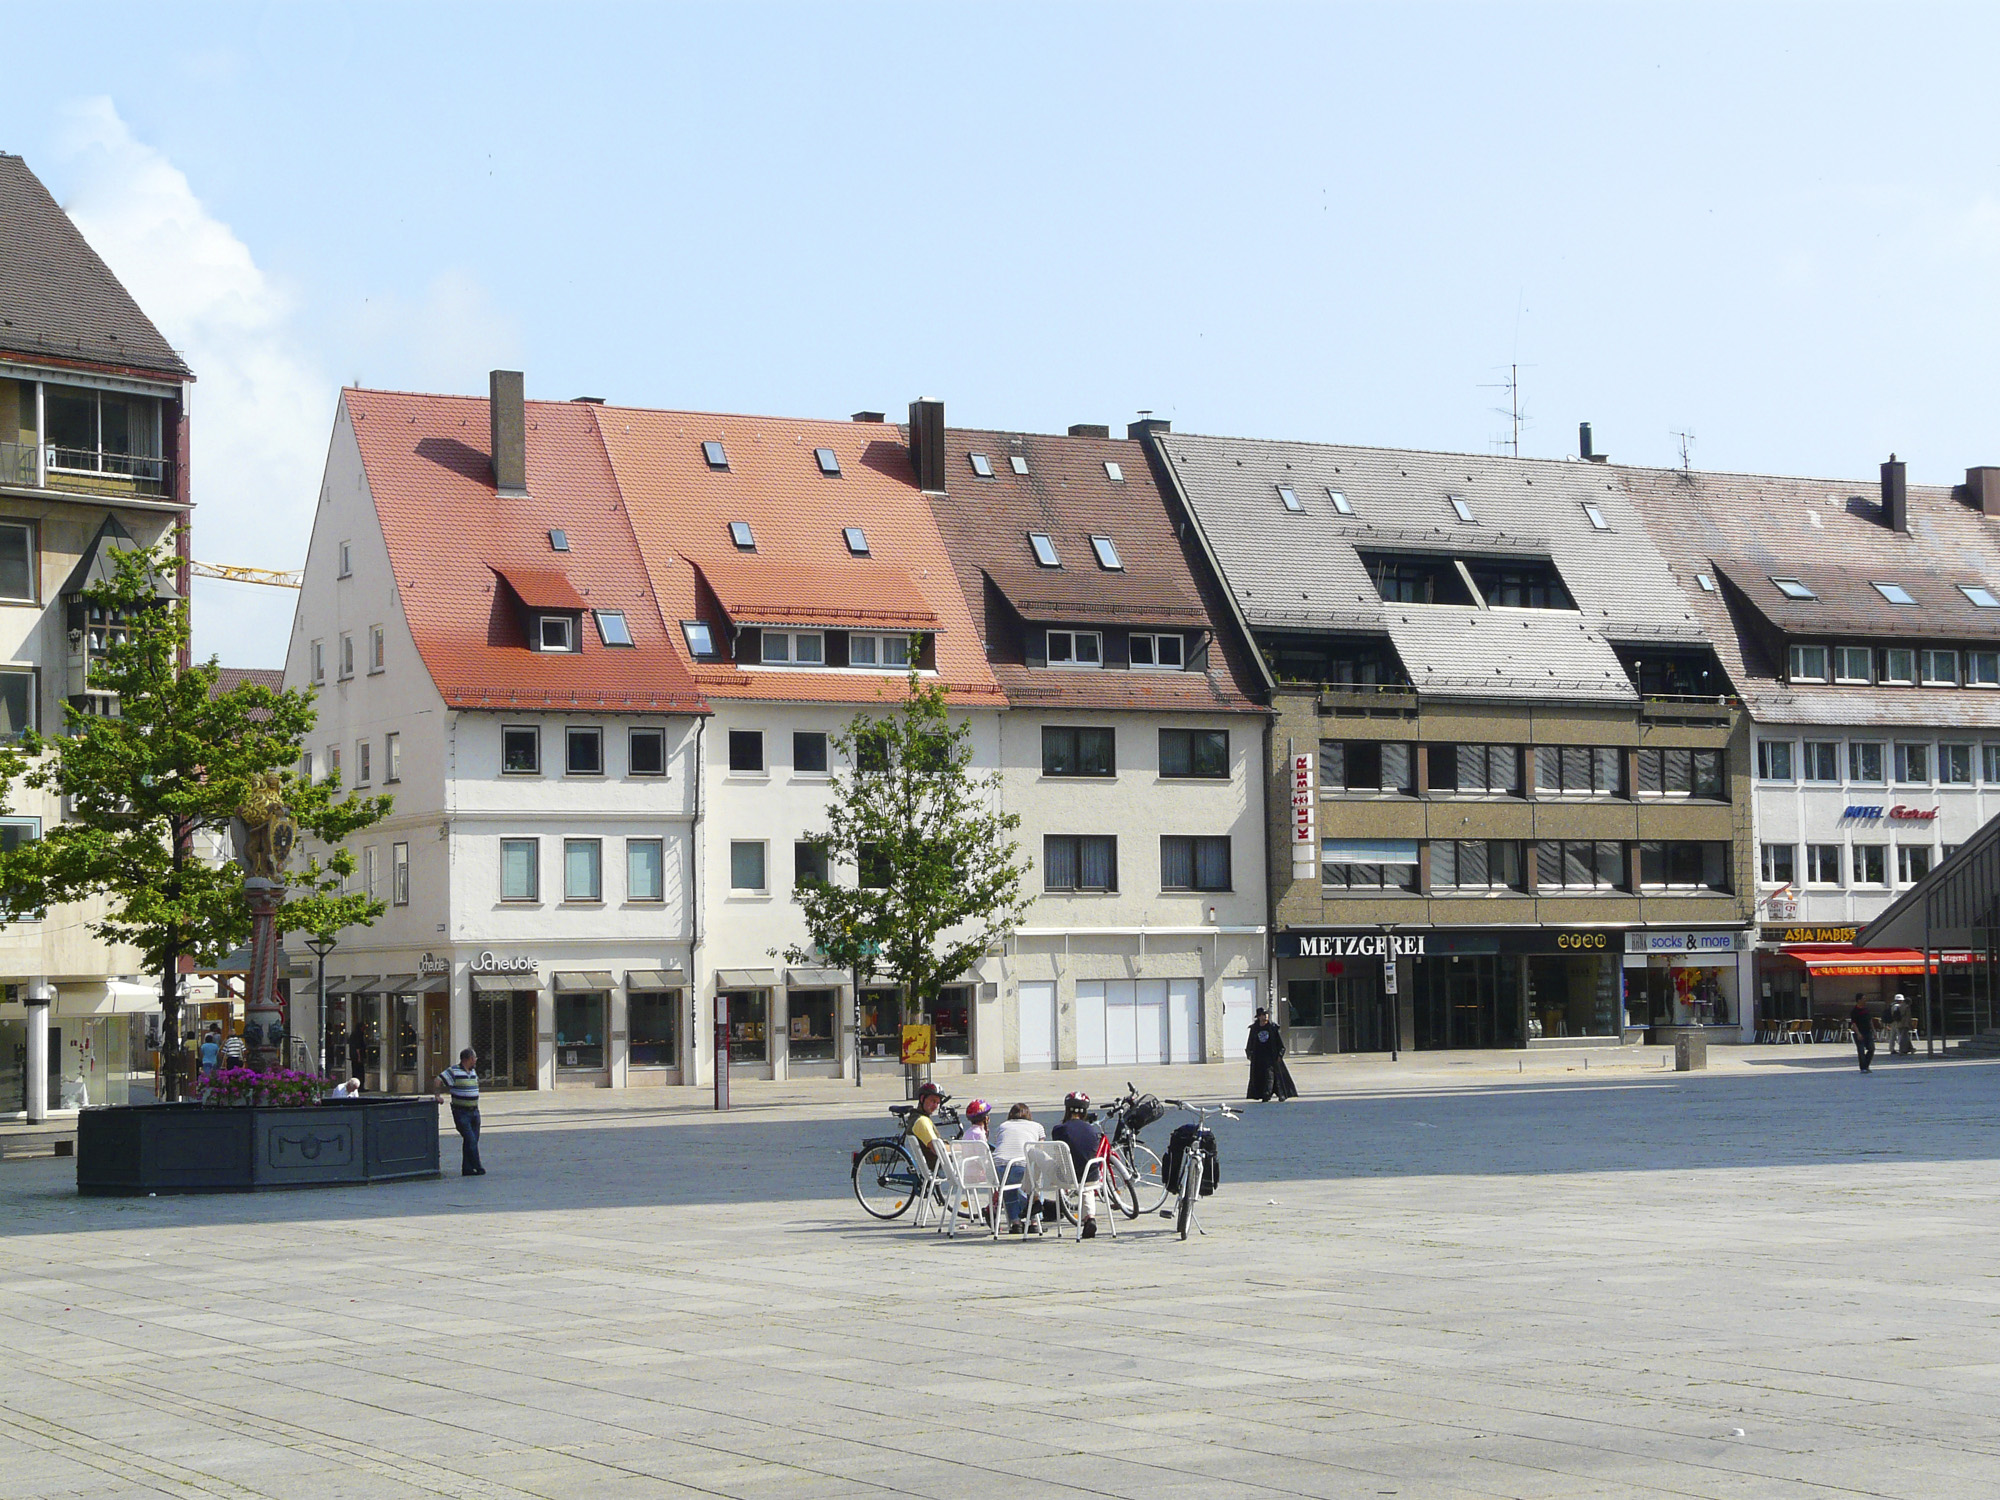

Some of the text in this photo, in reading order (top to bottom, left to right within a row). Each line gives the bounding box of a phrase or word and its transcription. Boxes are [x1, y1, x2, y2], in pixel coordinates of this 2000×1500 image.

[1296, 757, 1309, 839] KLEIBER
[1844, 806, 1940, 819] HOTEL Garni
[1558, 934, 1606, 948] aran
[1651, 935, 1683, 948] socks
[1686, 933, 1698, 950] &
[1701, 936, 1730, 948] more
[1785, 928, 1857, 942] ASIA IMBISS
[1299, 935, 1426, 956] METZGEREI
[470, 951, 540, 971] Scheuble
